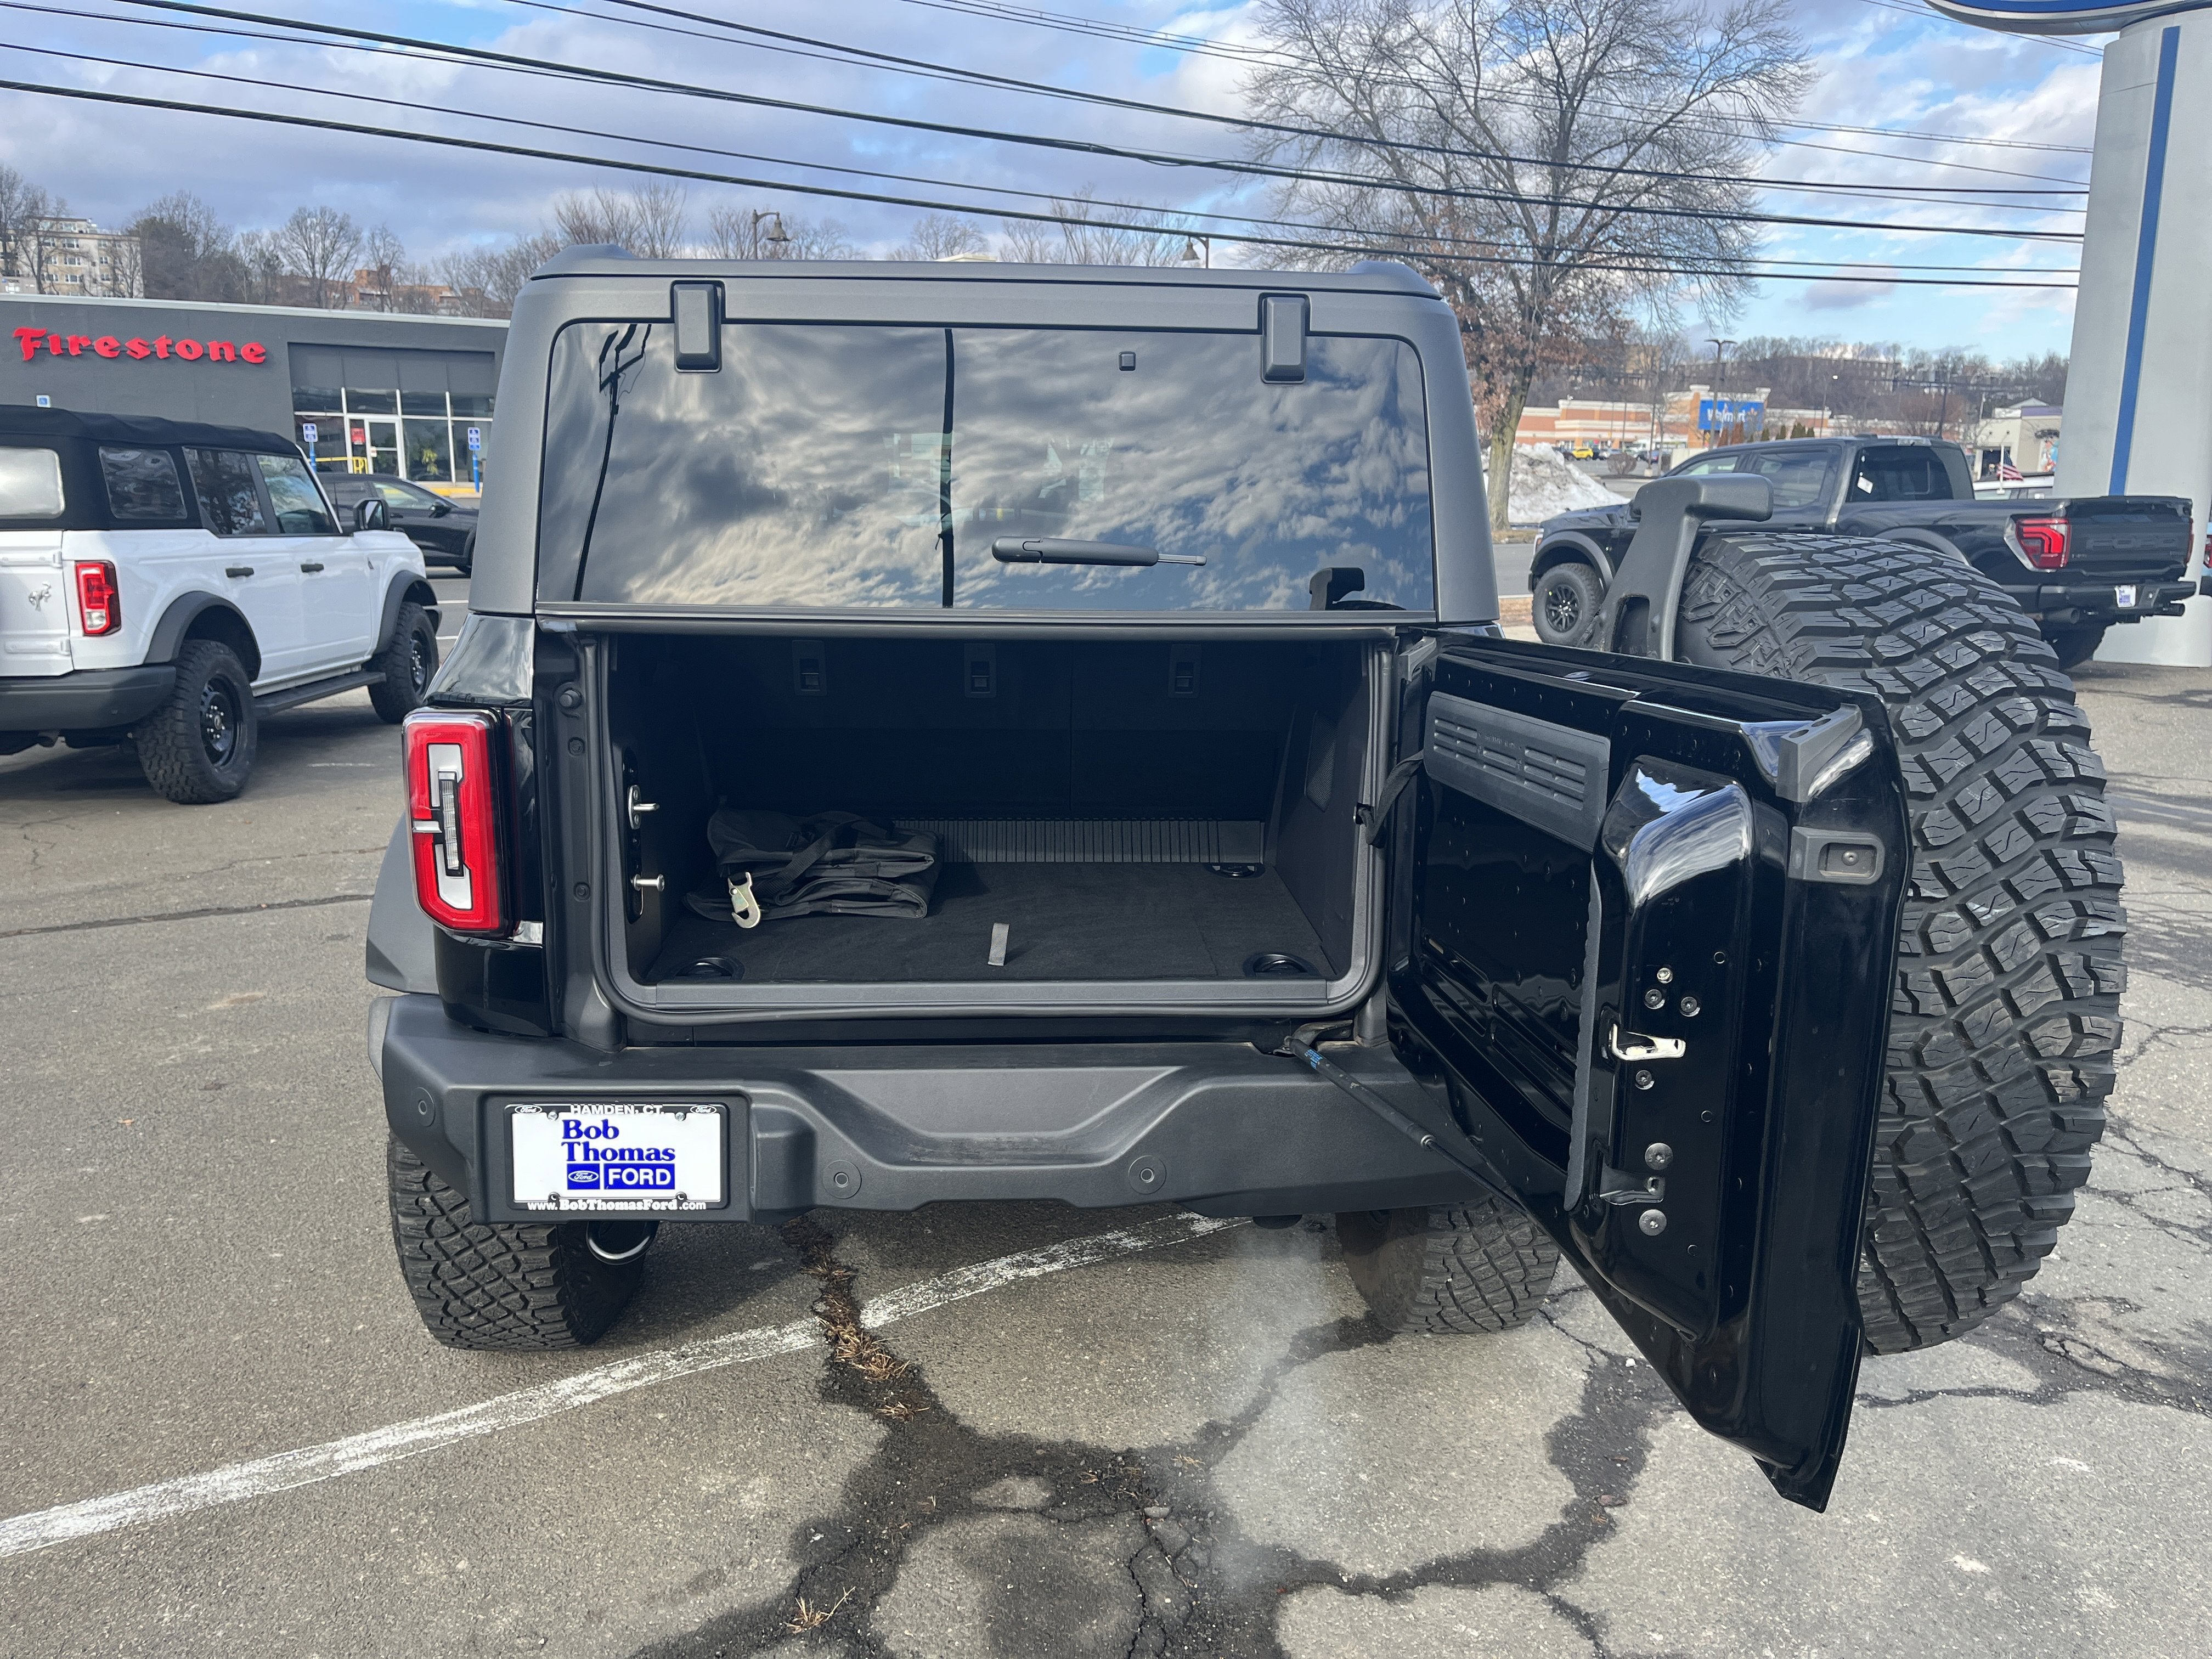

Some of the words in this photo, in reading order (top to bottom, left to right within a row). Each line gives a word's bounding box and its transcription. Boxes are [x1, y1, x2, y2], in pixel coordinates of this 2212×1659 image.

[13, 327, 267, 364] Firestone
[1707, 408, 1745, 422] Walmrt
[571, 1104, 639, 1115] HAMDEN,
[642, 1104, 664, 1115] CT.
[562, 1119, 619, 1139] Bob
[561, 1141, 675, 1161] Thomas
[573, 1171, 594, 1181] Ford
[608, 1168, 671, 1185] FORD
[527, 1199, 706, 1210] www.BobThomasFord.com
